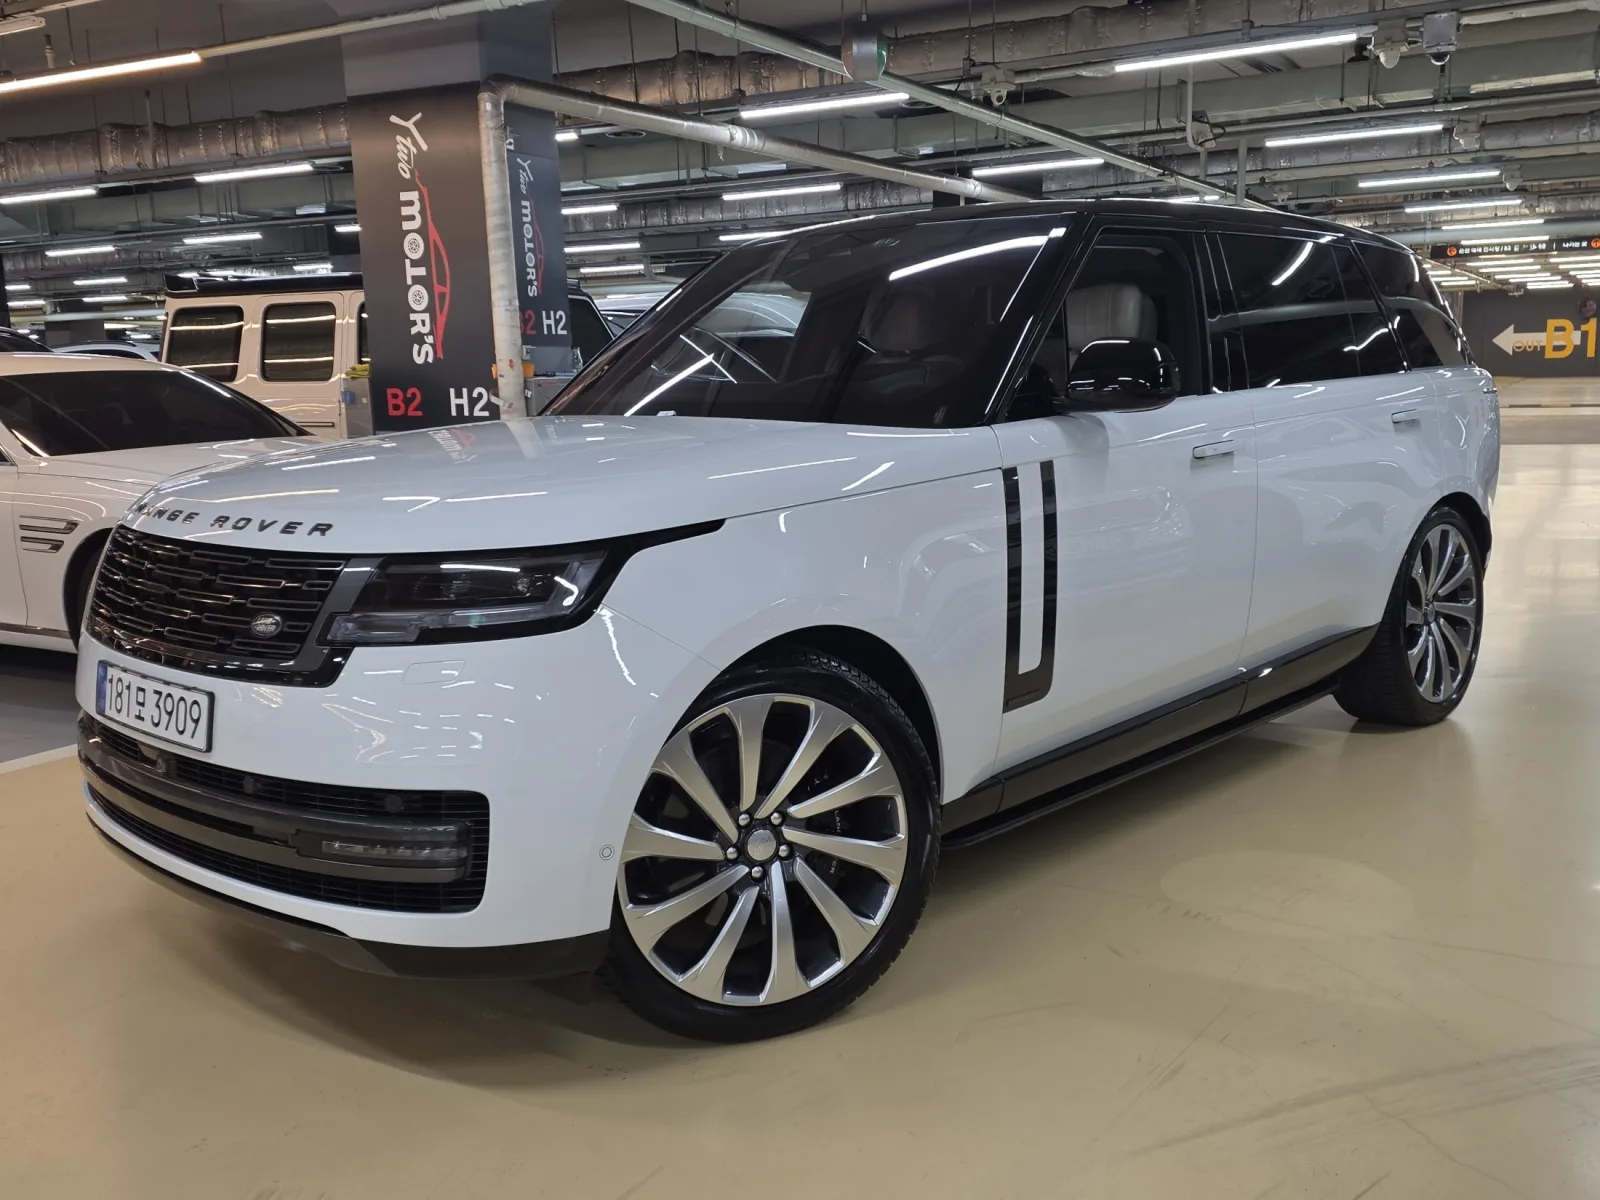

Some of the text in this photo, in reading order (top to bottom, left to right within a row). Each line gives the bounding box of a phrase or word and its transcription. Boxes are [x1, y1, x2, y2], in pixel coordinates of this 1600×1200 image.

[542, 310, 568, 335] H2
[1513, 340, 1544, 352] OUT
[1545, 317, 1597, 358] B1
[386, 387, 490, 416] B2 H2
[210, 514, 334, 537] ROVER
[151, 689, 202, 739] 3909
